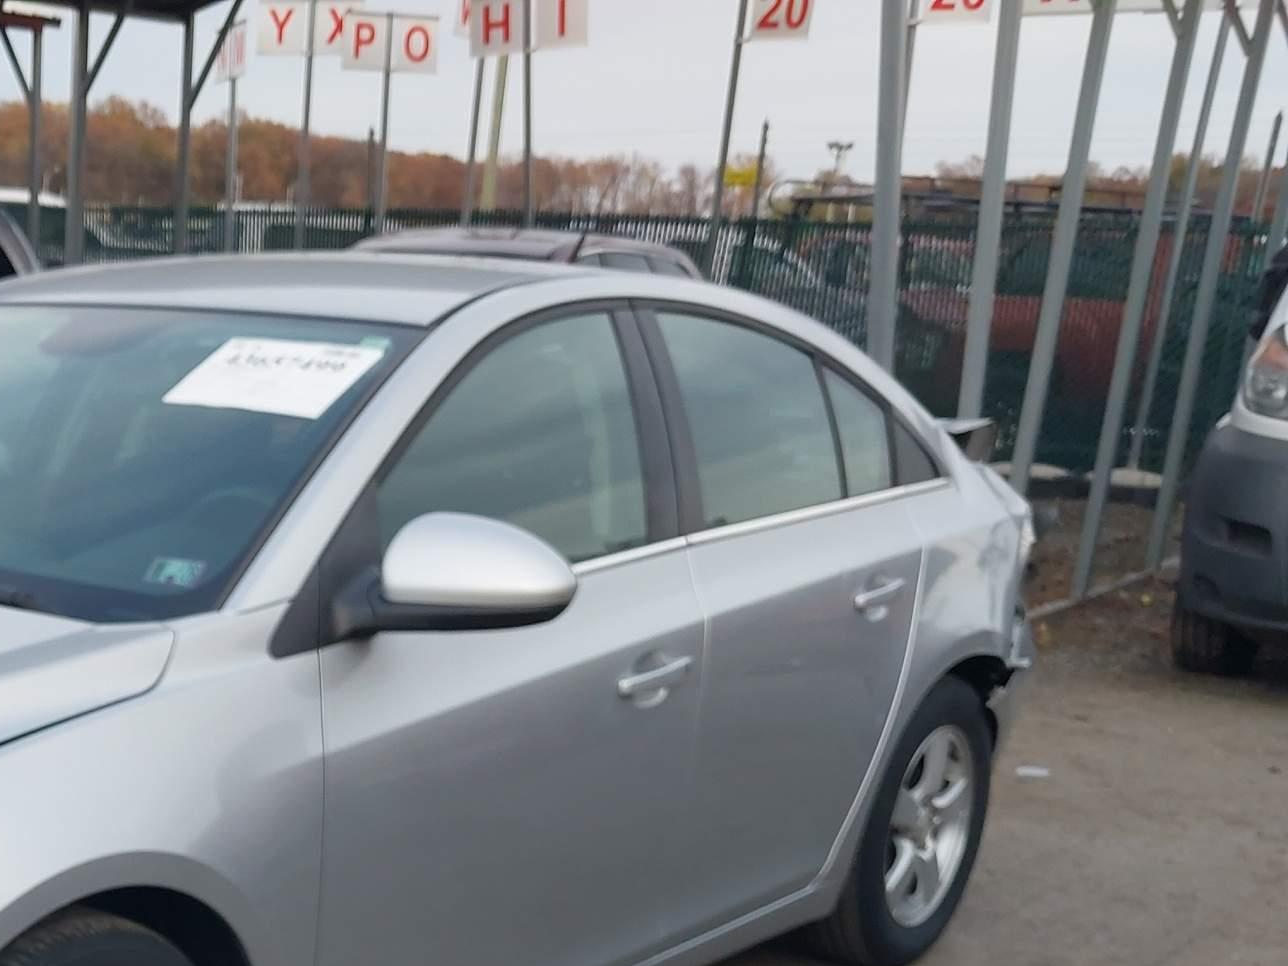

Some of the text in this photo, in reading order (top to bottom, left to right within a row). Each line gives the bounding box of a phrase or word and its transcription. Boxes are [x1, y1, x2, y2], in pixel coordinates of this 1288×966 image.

[268, 8, 294, 45] Y
[482, 4, 510, 44] H
[756, 0, 810, 30] 20
[352, 22, 376, 60] P
